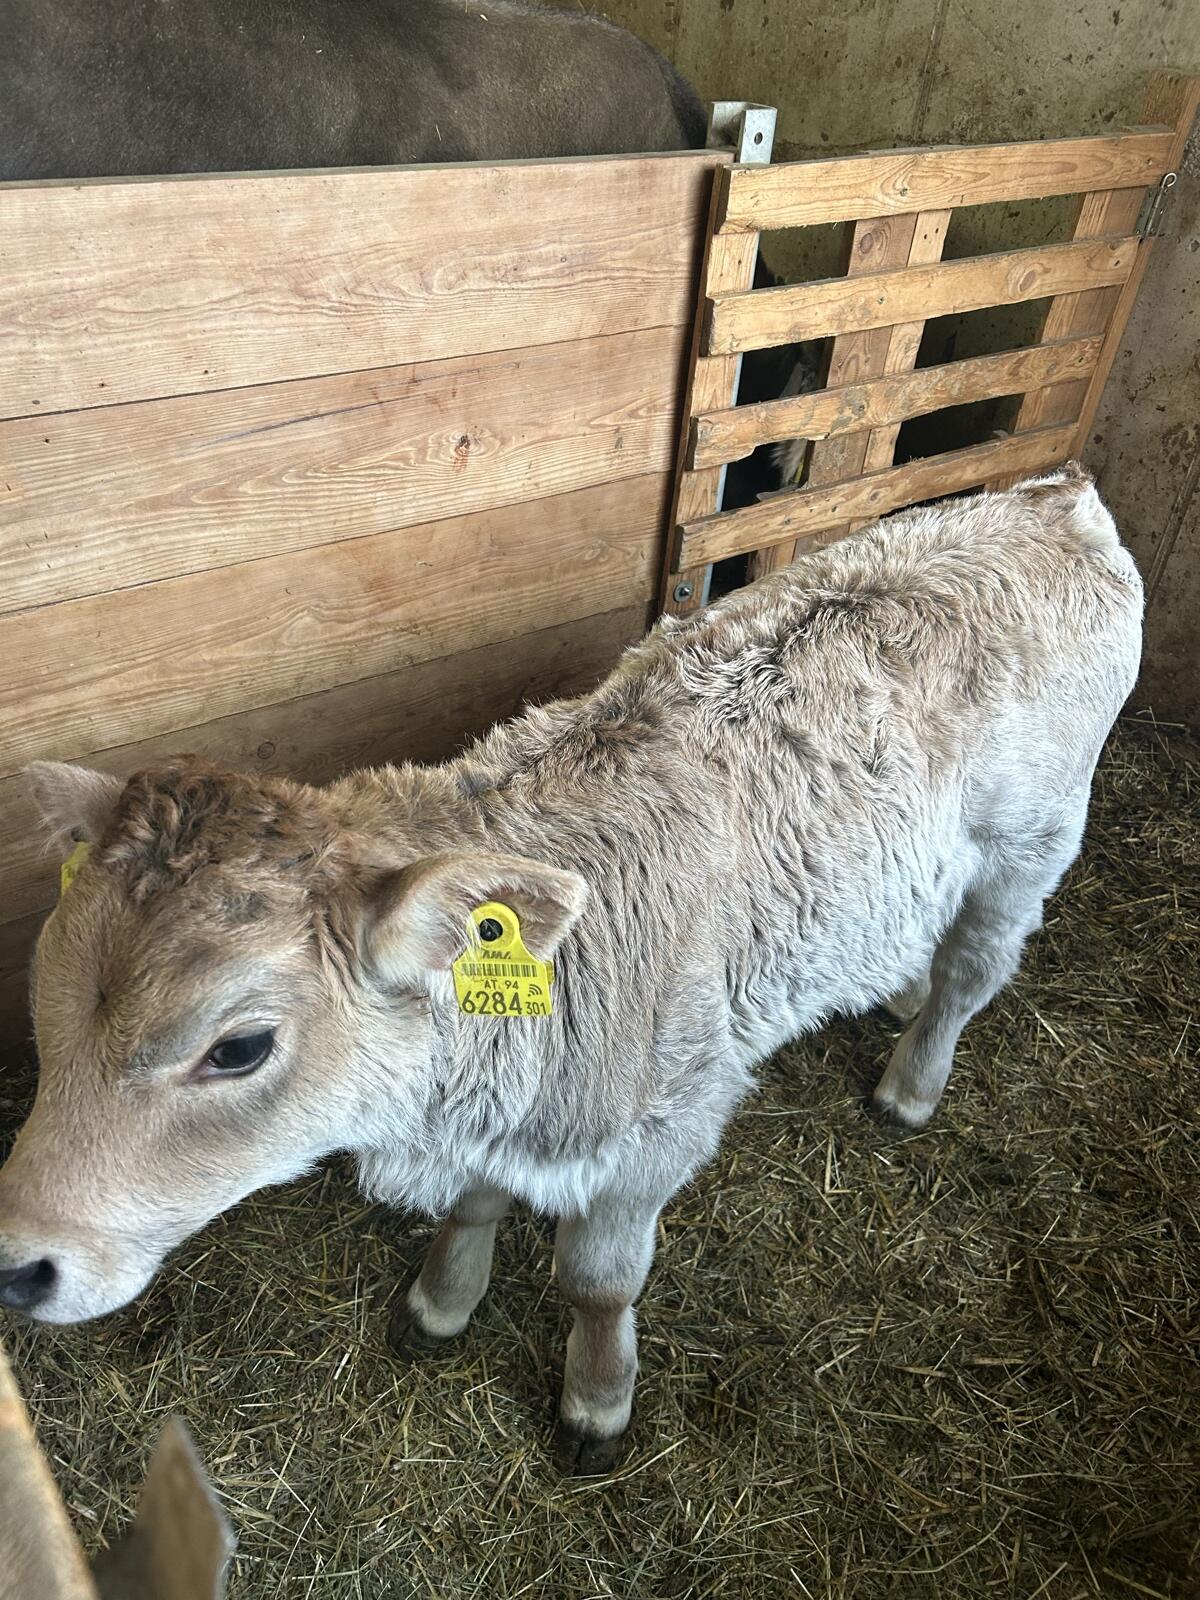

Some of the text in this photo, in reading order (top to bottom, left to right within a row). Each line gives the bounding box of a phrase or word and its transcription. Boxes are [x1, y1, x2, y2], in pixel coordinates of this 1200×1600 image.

[484, 979, 519, 990] AT 94
[462, 990, 547, 1015] 6284 301
